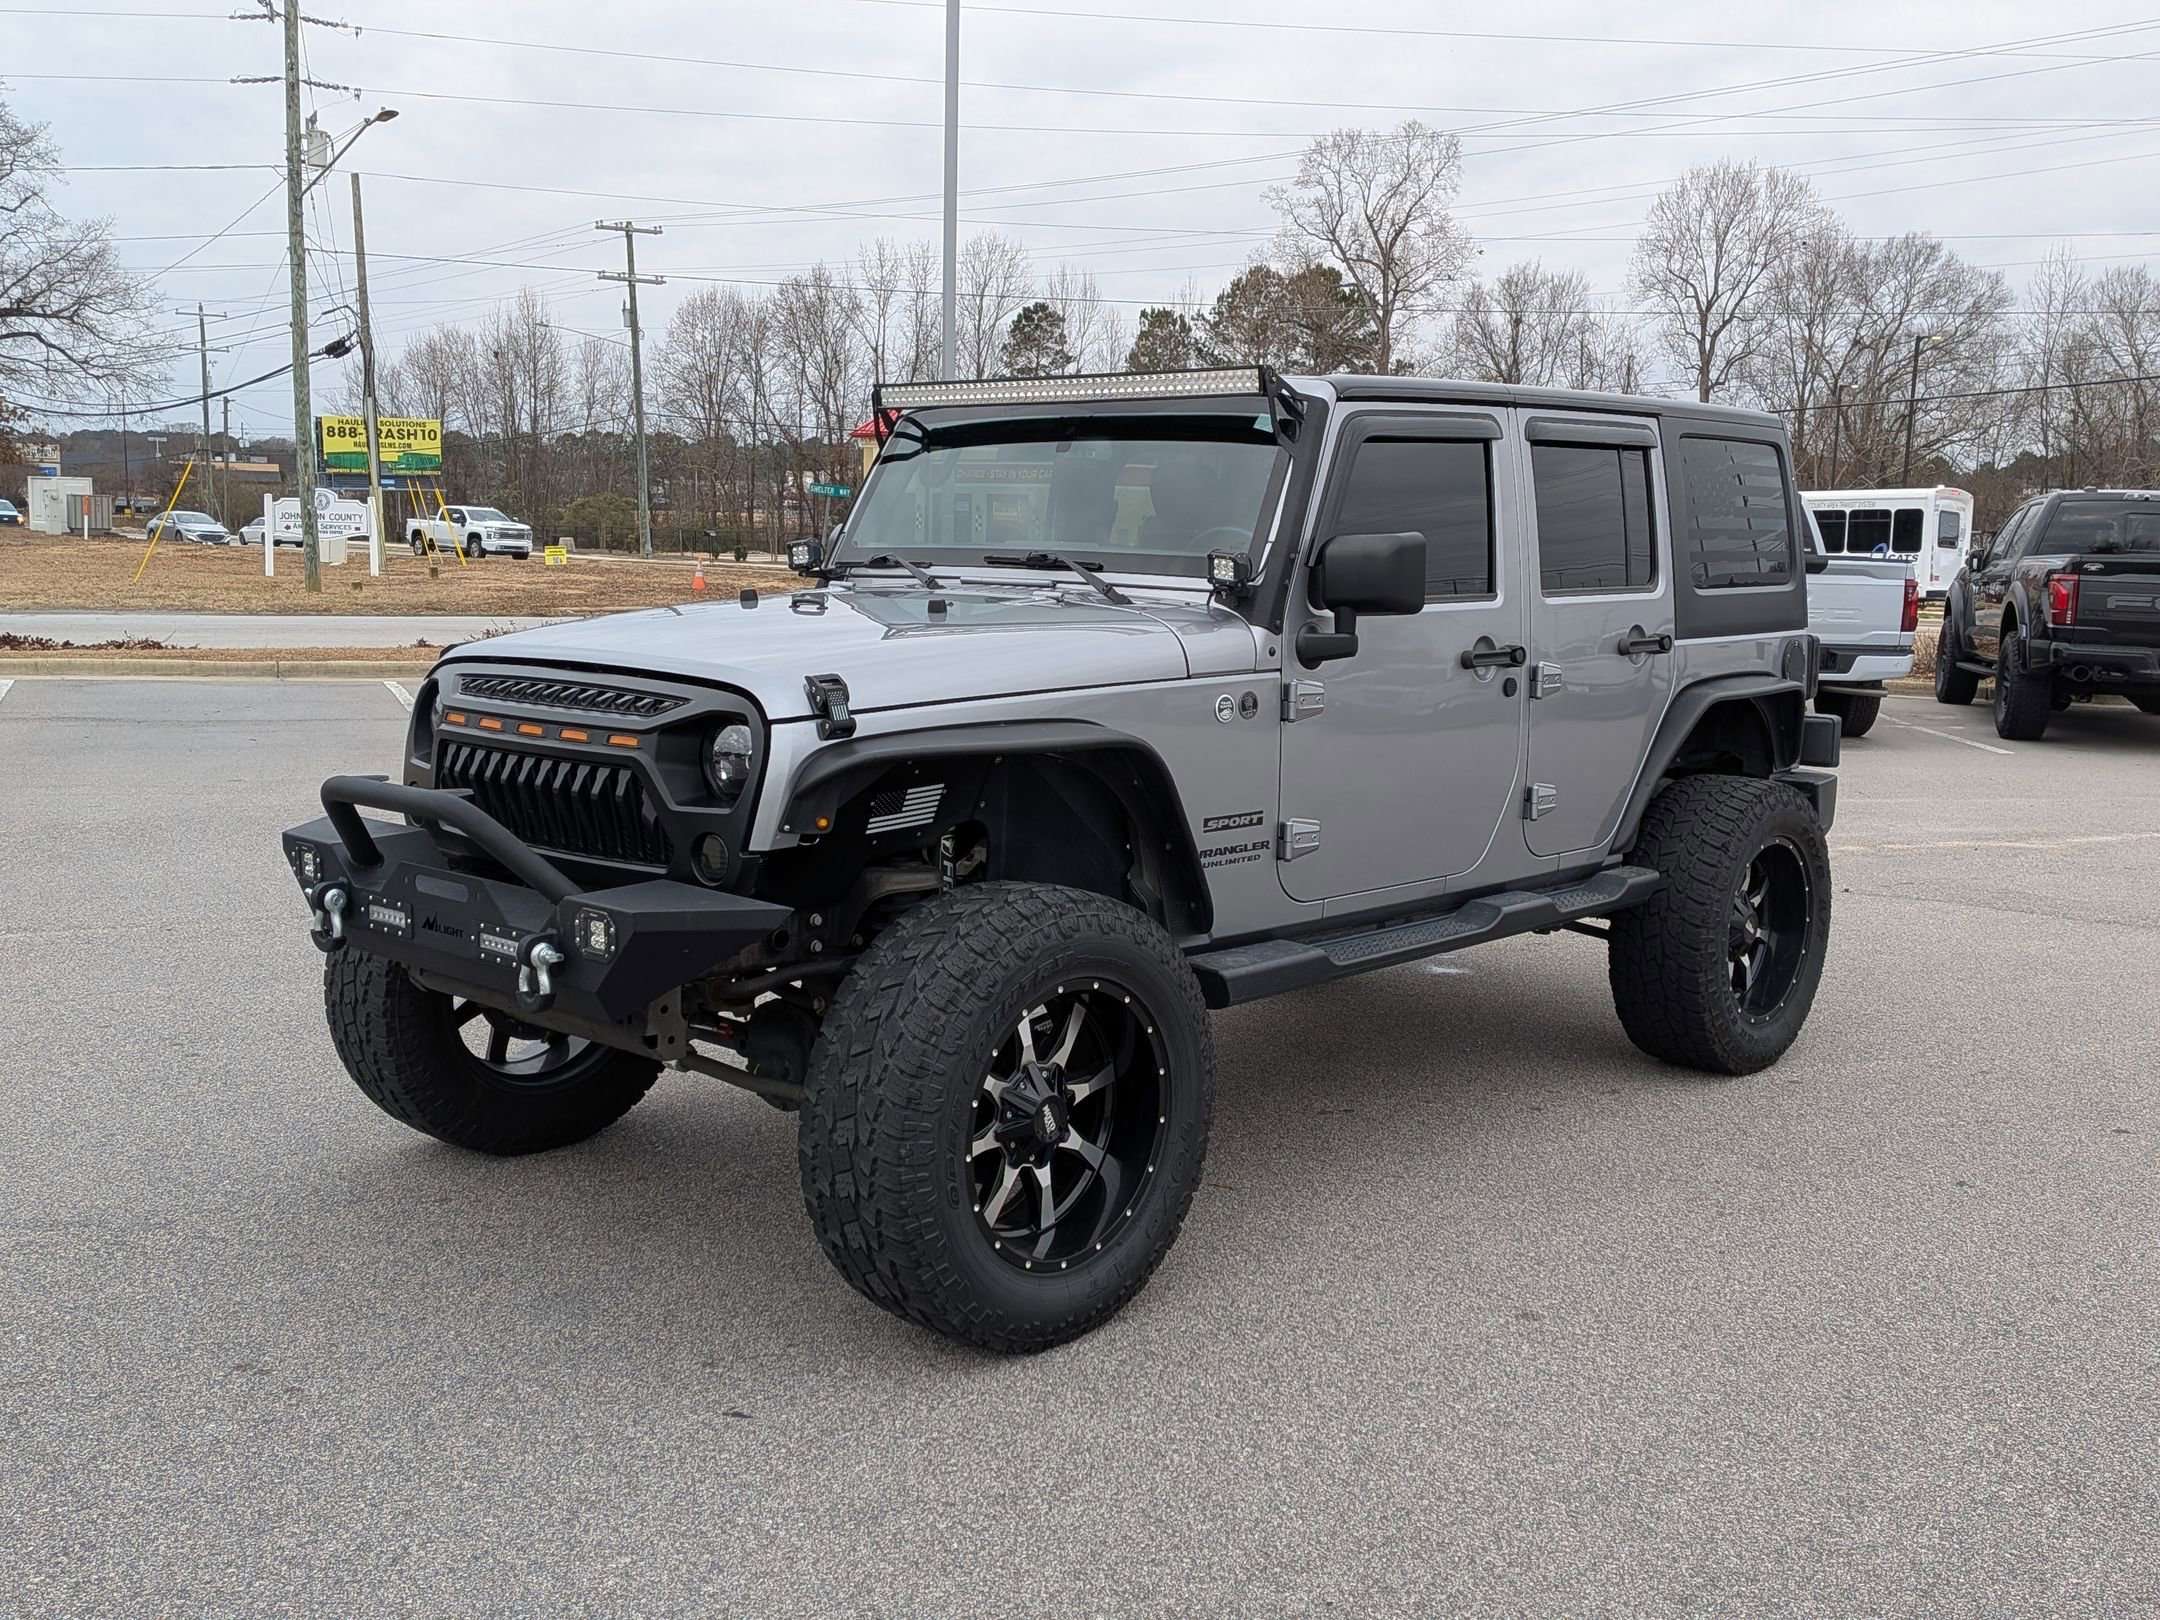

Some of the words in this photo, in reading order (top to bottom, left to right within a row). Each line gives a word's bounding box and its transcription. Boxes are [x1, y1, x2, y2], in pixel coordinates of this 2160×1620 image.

[337, 418, 364, 426] HAULI
[379, 420, 427, 428] SOLUTIONS
[326, 425, 438, 441] 888-RASH10
[810, 484, 835, 495] SHELTER
[839, 488, 851, 497] WAY
[328, 513, 364, 522] COUNTY
[1204, 813, 1264, 831] SPORT
[1202, 854, 1261, 869] UNLIMITED
